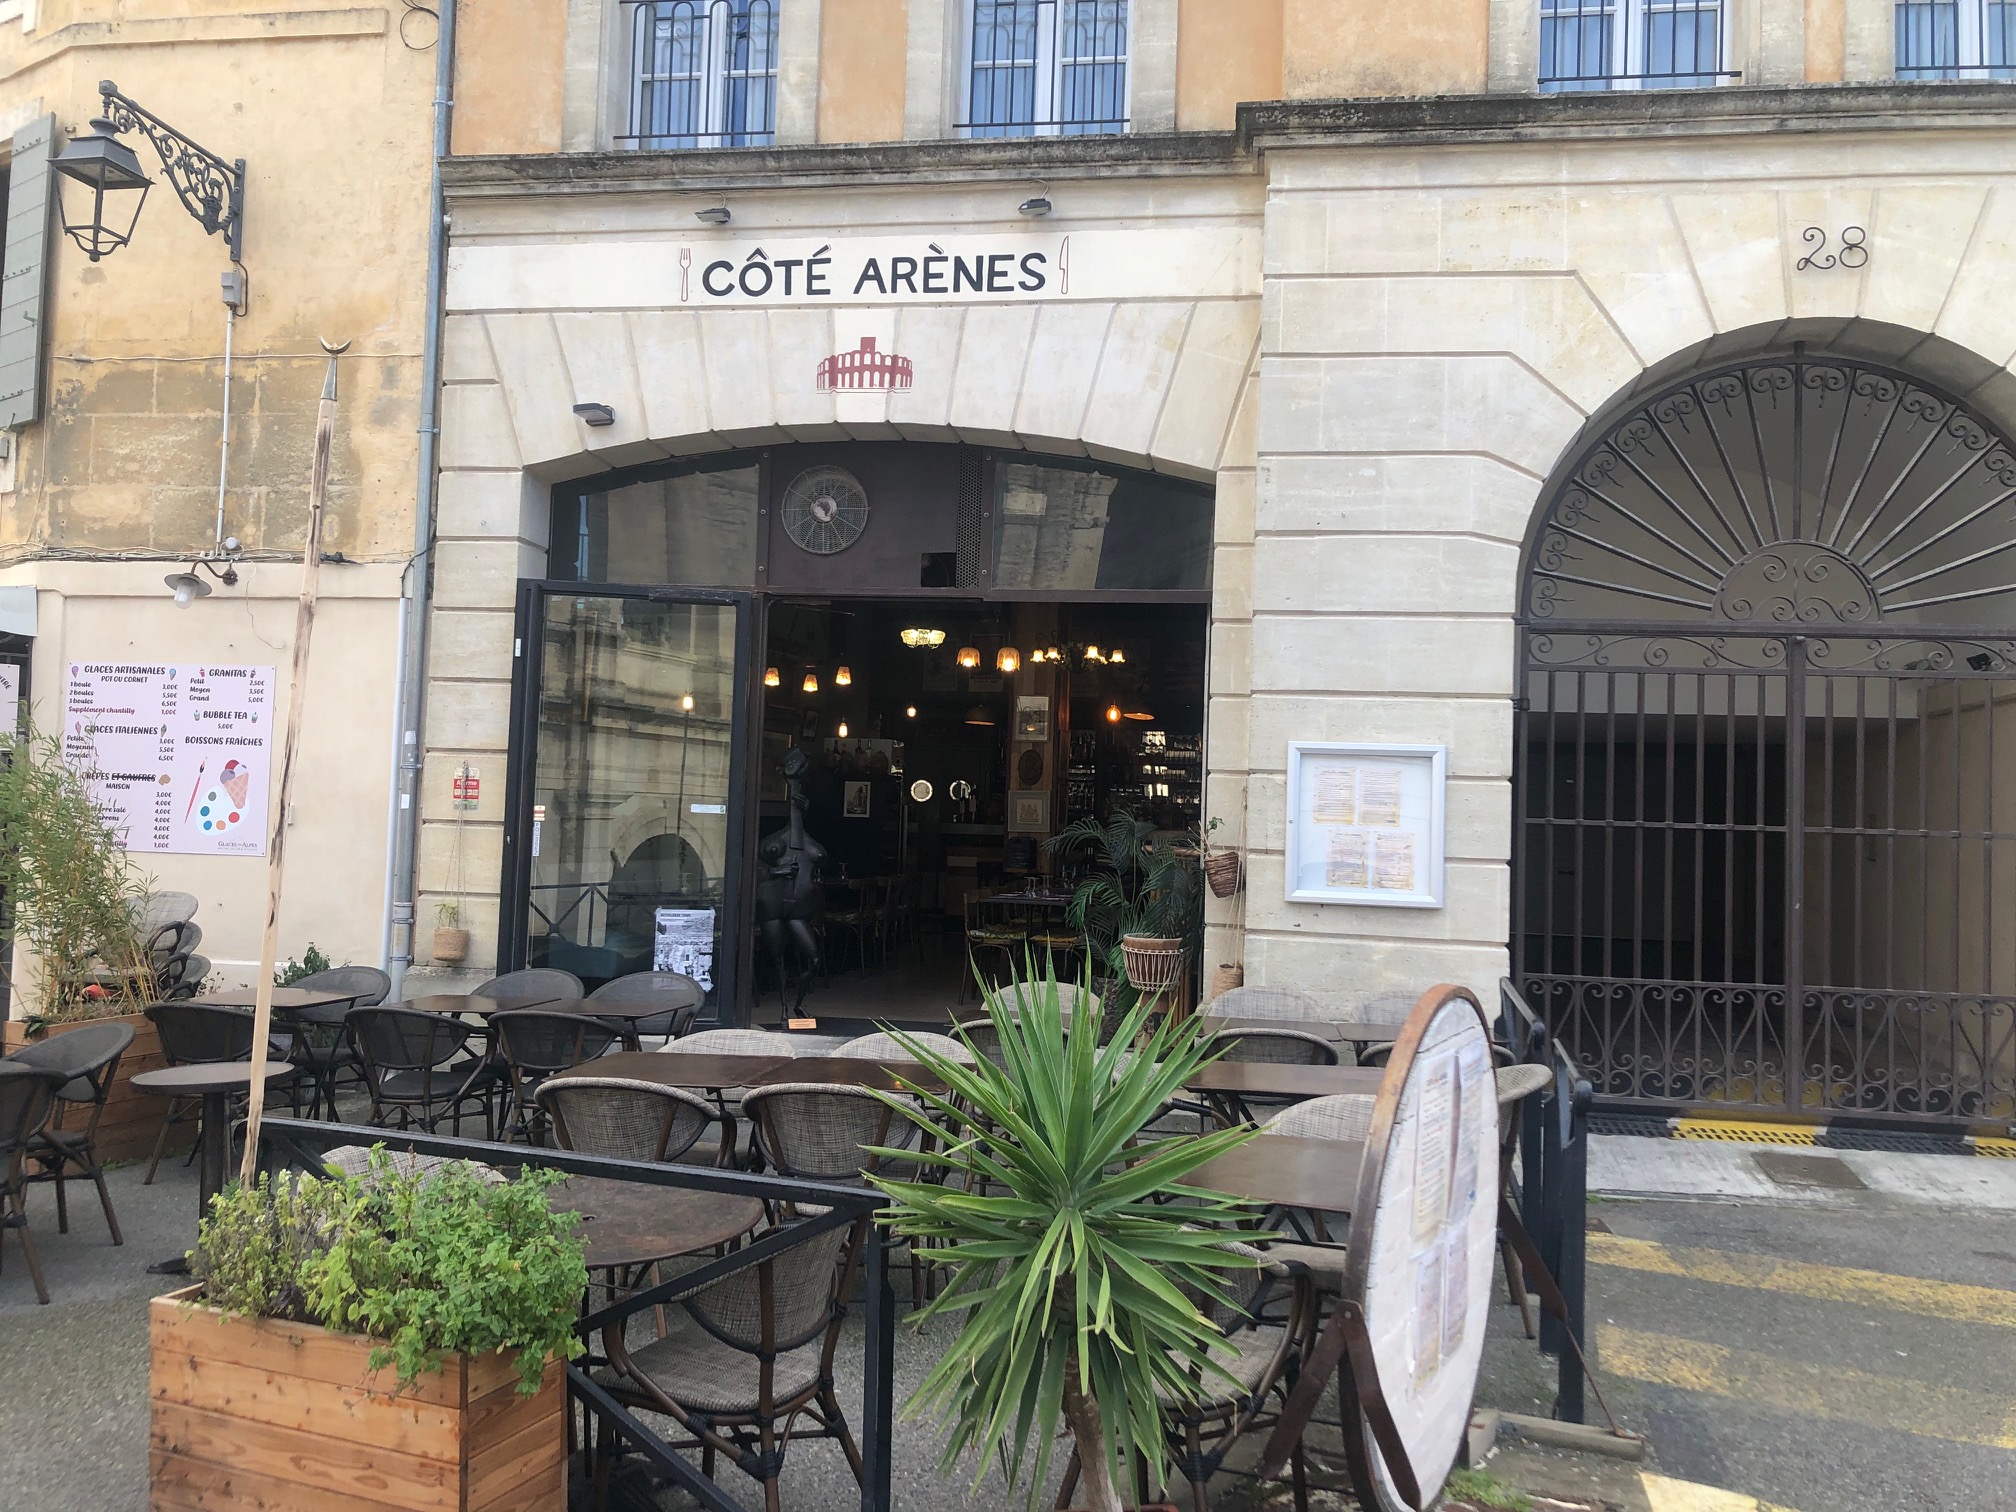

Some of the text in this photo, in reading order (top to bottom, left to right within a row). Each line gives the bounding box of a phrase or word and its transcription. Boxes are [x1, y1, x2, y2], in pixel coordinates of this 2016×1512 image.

[1797, 226, 1868, 271] 28
[702, 243, 1047, 297] CÔTÉ ARÈNES
[84, 665, 166, 675] GLACES ARTISANALES
[209, 668, 247, 678] GRANITAS
[190, 686, 211, 694] Moyen
[68, 706, 135, 715] Supplément chantilly
[203, 710, 248, 720] BUBBLE TEA
[115, 725, 159, 735] ITALIENNES
[185, 736, 264, 747] BOISSONS FRAÎCHES
